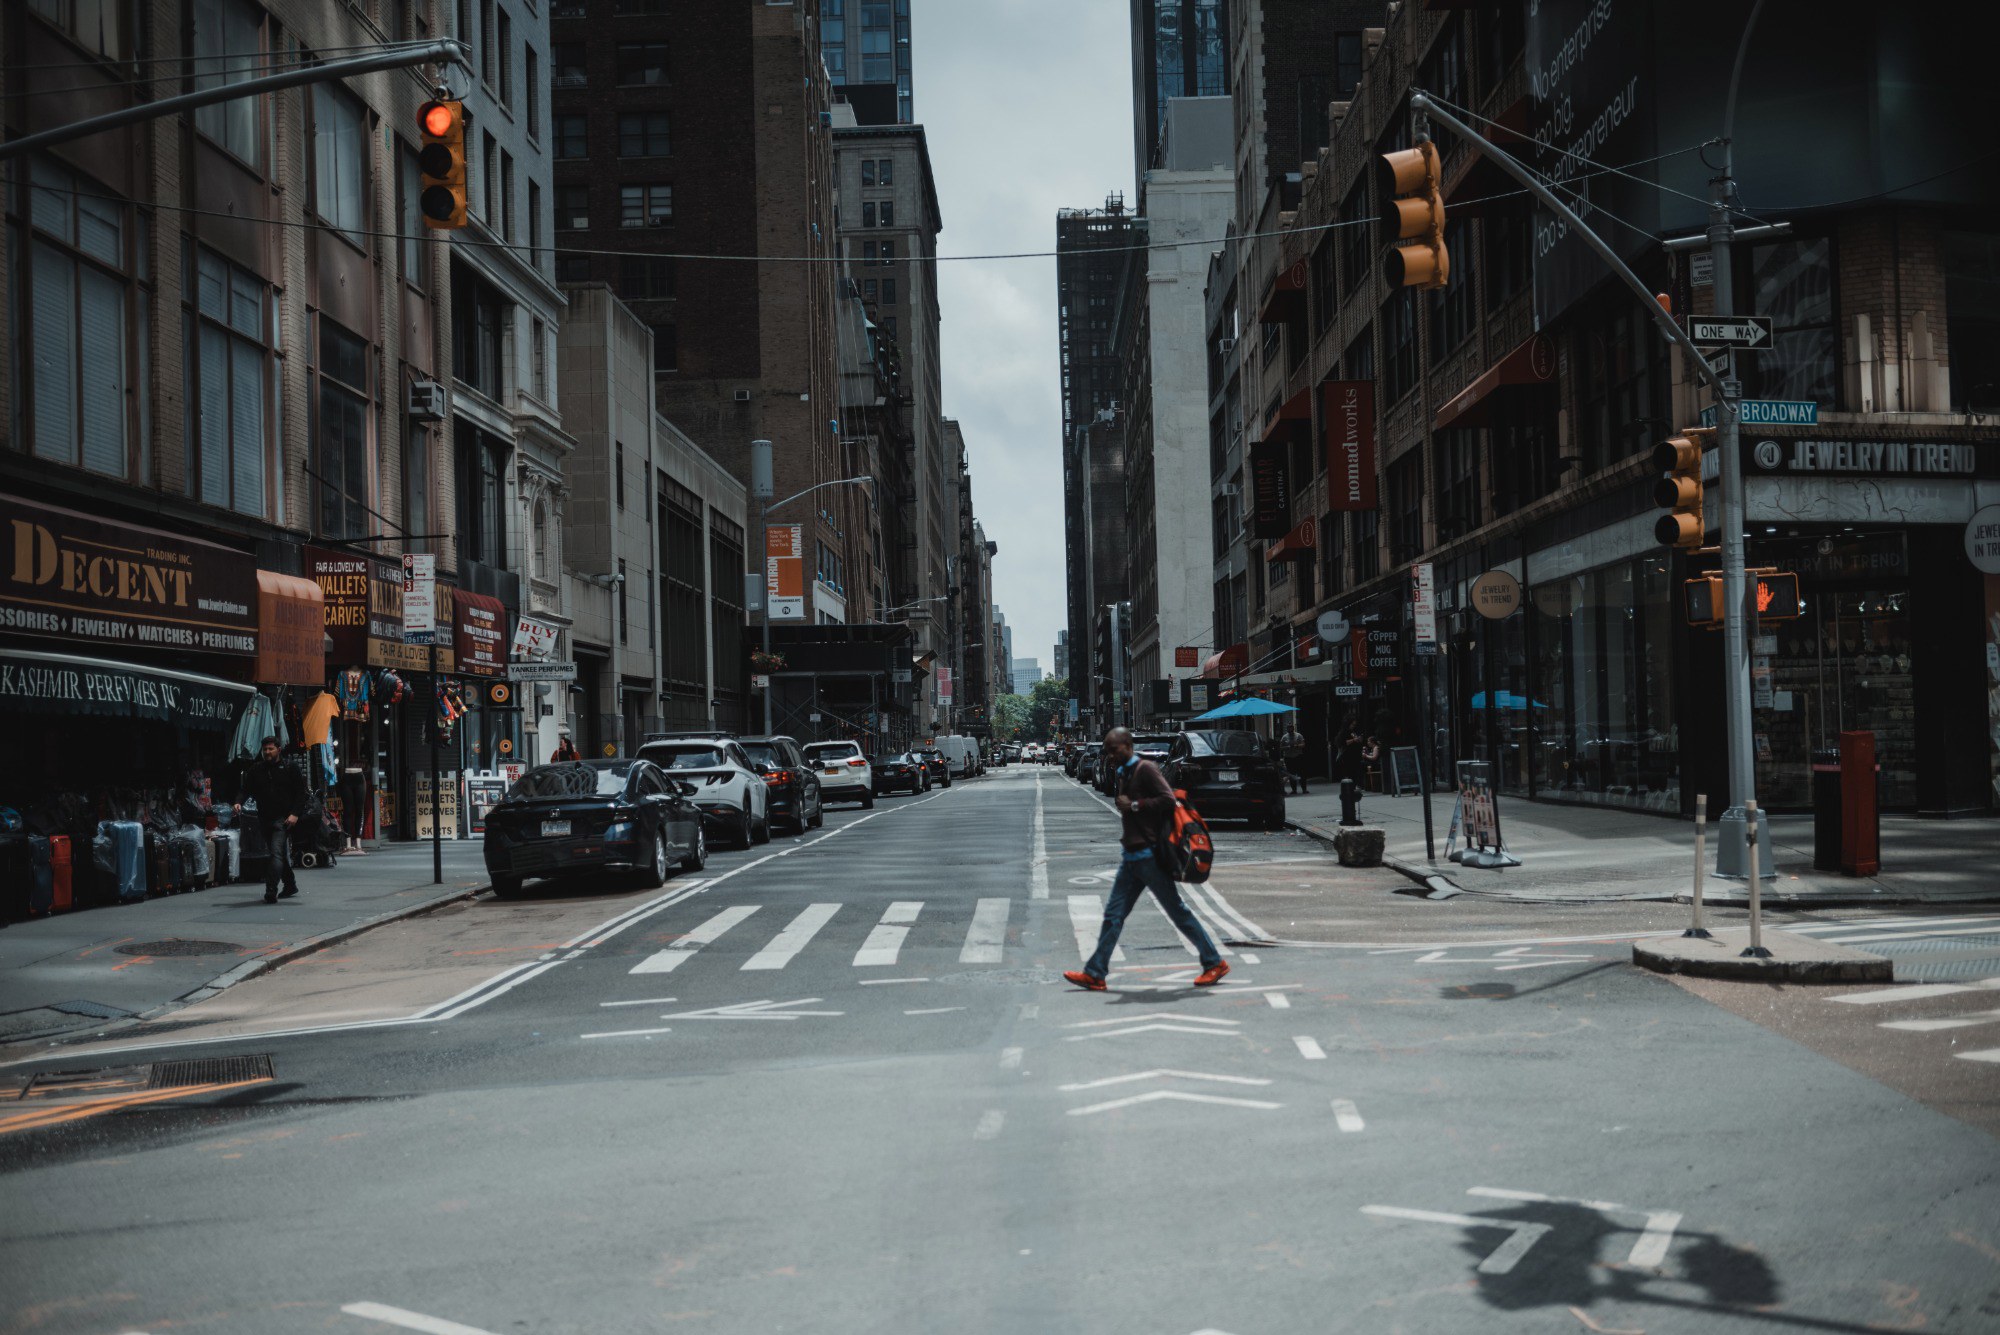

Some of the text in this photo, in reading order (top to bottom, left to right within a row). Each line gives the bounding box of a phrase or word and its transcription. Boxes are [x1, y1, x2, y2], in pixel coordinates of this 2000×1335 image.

[1533, 0, 1612, 110] No enterprise
[1534, 92, 1575, 158] too big.
[1553, 75, 1638, 186] entrepreneur
[1538, 218, 1555, 258] too
[1701, 326, 1760, 339] ONE WAY
[1741, 403, 1815, 422] BROADWAY
[1341, 388, 1361, 502] nomadworks
[1789, 441, 1975, 473] JEWELRY IN TREND
[1277, 470, 1285, 509] CANTINA
[791, 526, 802, 557] NOMAD
[1974, 543, 1984, 557] IN
[11, 519, 192, 607] DECENT
[146, 548, 192, 565] TRADING INC.
[316, 562, 367, 573] FAIR & LOVELY INC.
[316, 575, 367, 595] WALLETS
[406, 582, 412, 591] 3
[767, 558, 779, 597] FLATIRON
[370, 579, 403, 618] WALLE
[1480, 585, 1510, 594] JEWELRY
[1481, 594, 1512, 604] IN TREND
[323, 606, 366, 625] CARVES
[71, 617, 128, 639] JEWELRY
[137, 625, 193, 645] WATCHES
[202, 632, 255, 651] PERFUMES
[519, 622, 556, 639] BUY
[528, 635, 541, 646] N
[1375, 645, 1391, 654] MUG
[380, 643, 395, 656] FAIR
[405, 646, 430, 661] LOVELY
[538, 665, 574, 673] PERFUMES
[1369, 658, 1398, 667] COFFEE
[1, 665, 83, 700] KASHMIR
[506, 765, 518, 773] WE
[506, 773, 522, 781] PEN
[418, 781, 455, 791] LEAHER
[418, 807, 455, 816] SCAVES
